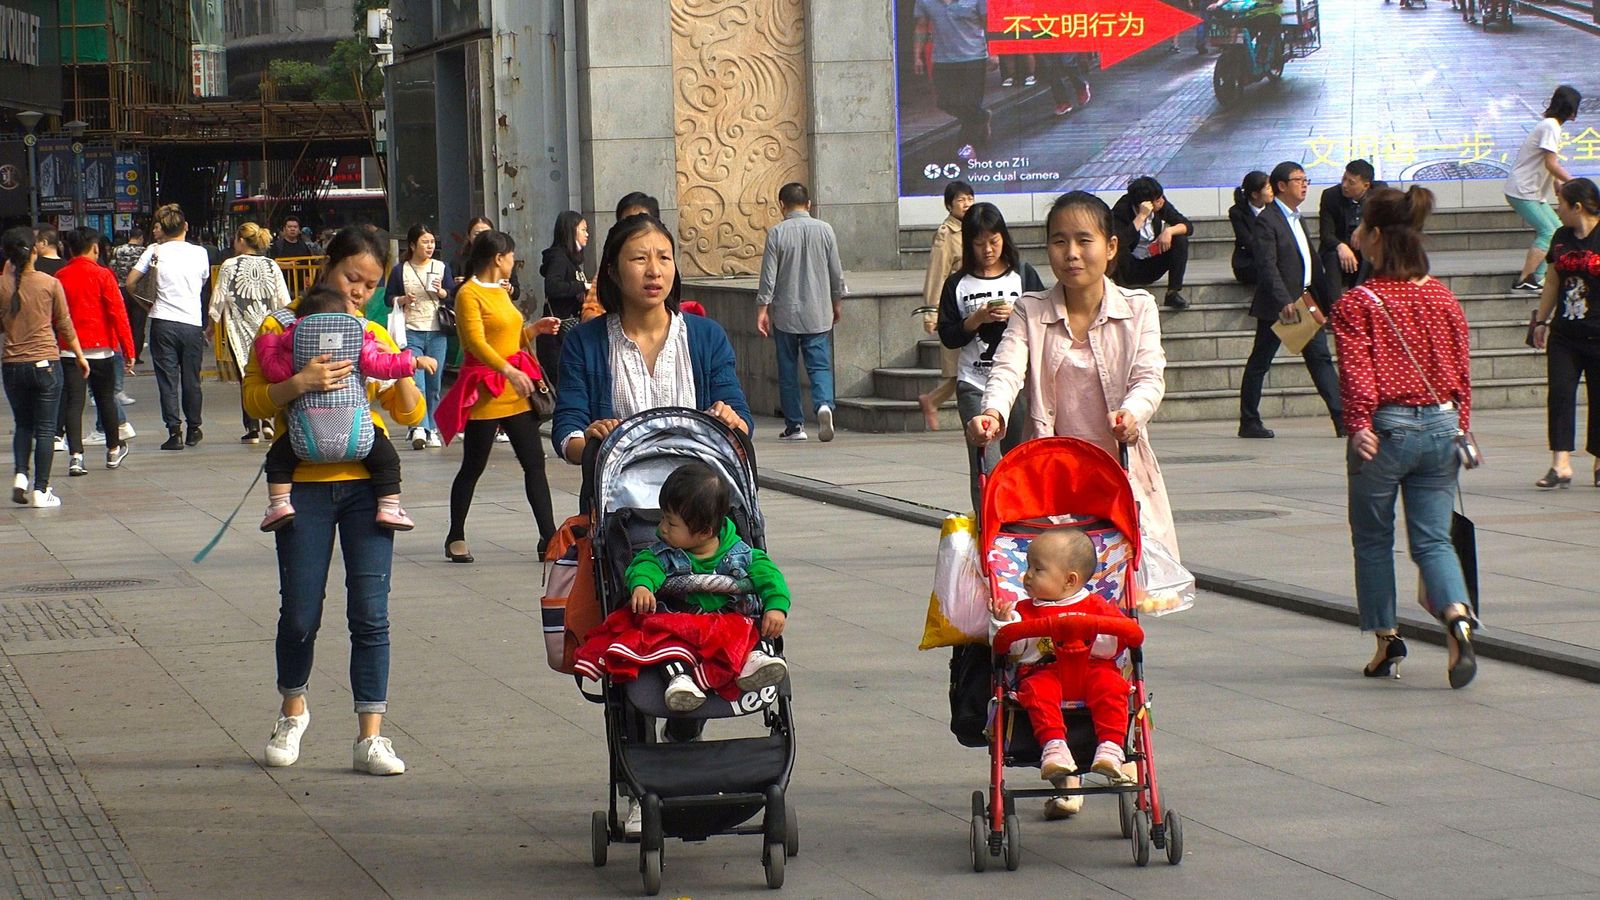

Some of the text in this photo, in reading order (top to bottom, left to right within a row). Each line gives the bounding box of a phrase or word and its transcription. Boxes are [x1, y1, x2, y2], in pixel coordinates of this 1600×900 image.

[1003, 11, 1145, 39] 不文明行为
[967, 157, 1030, 169] Shot on Z1i
[967, 170, 1060, 182] vivo dual camera
